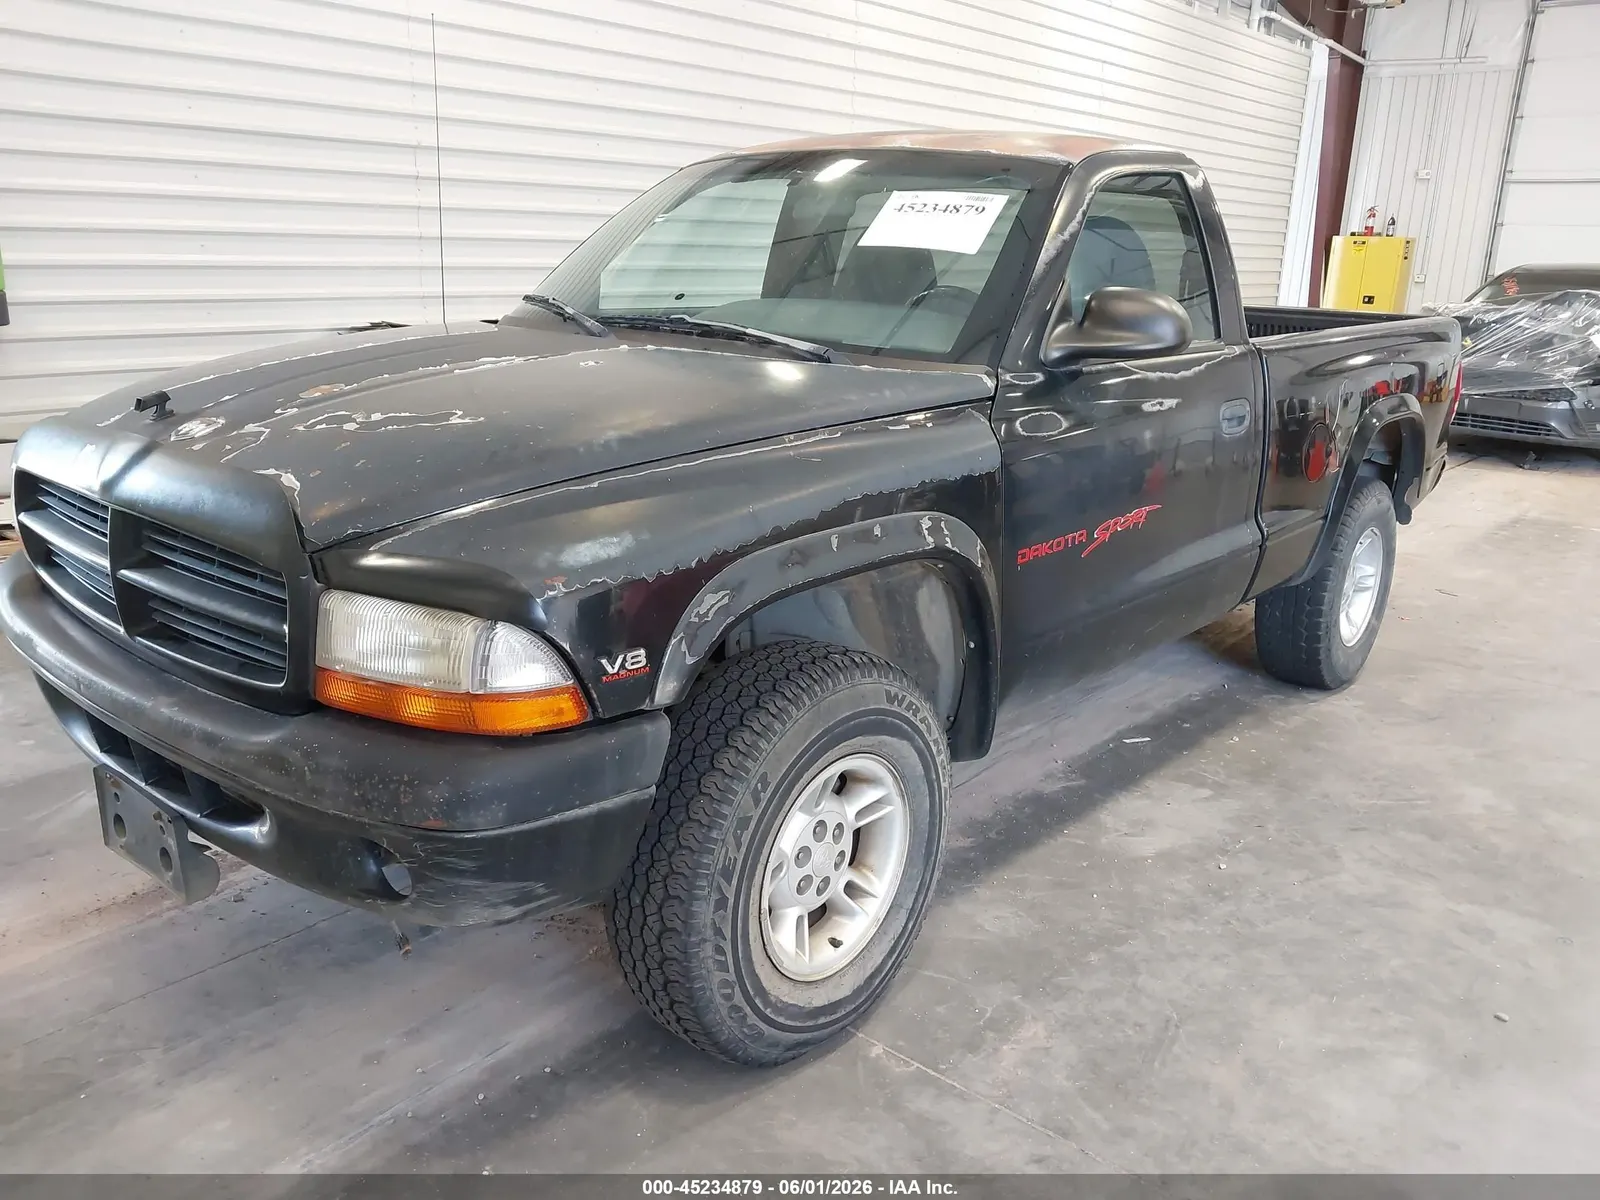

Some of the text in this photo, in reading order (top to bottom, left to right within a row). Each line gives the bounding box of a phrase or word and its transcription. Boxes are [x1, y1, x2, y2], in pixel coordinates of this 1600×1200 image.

[894, 202, 986, 215] 45234879
[1017, 504, 1163, 564] DAKOTA SPORT
[599, 647, 647, 674] V8
[601, 666, 650, 684] MAGNUM
